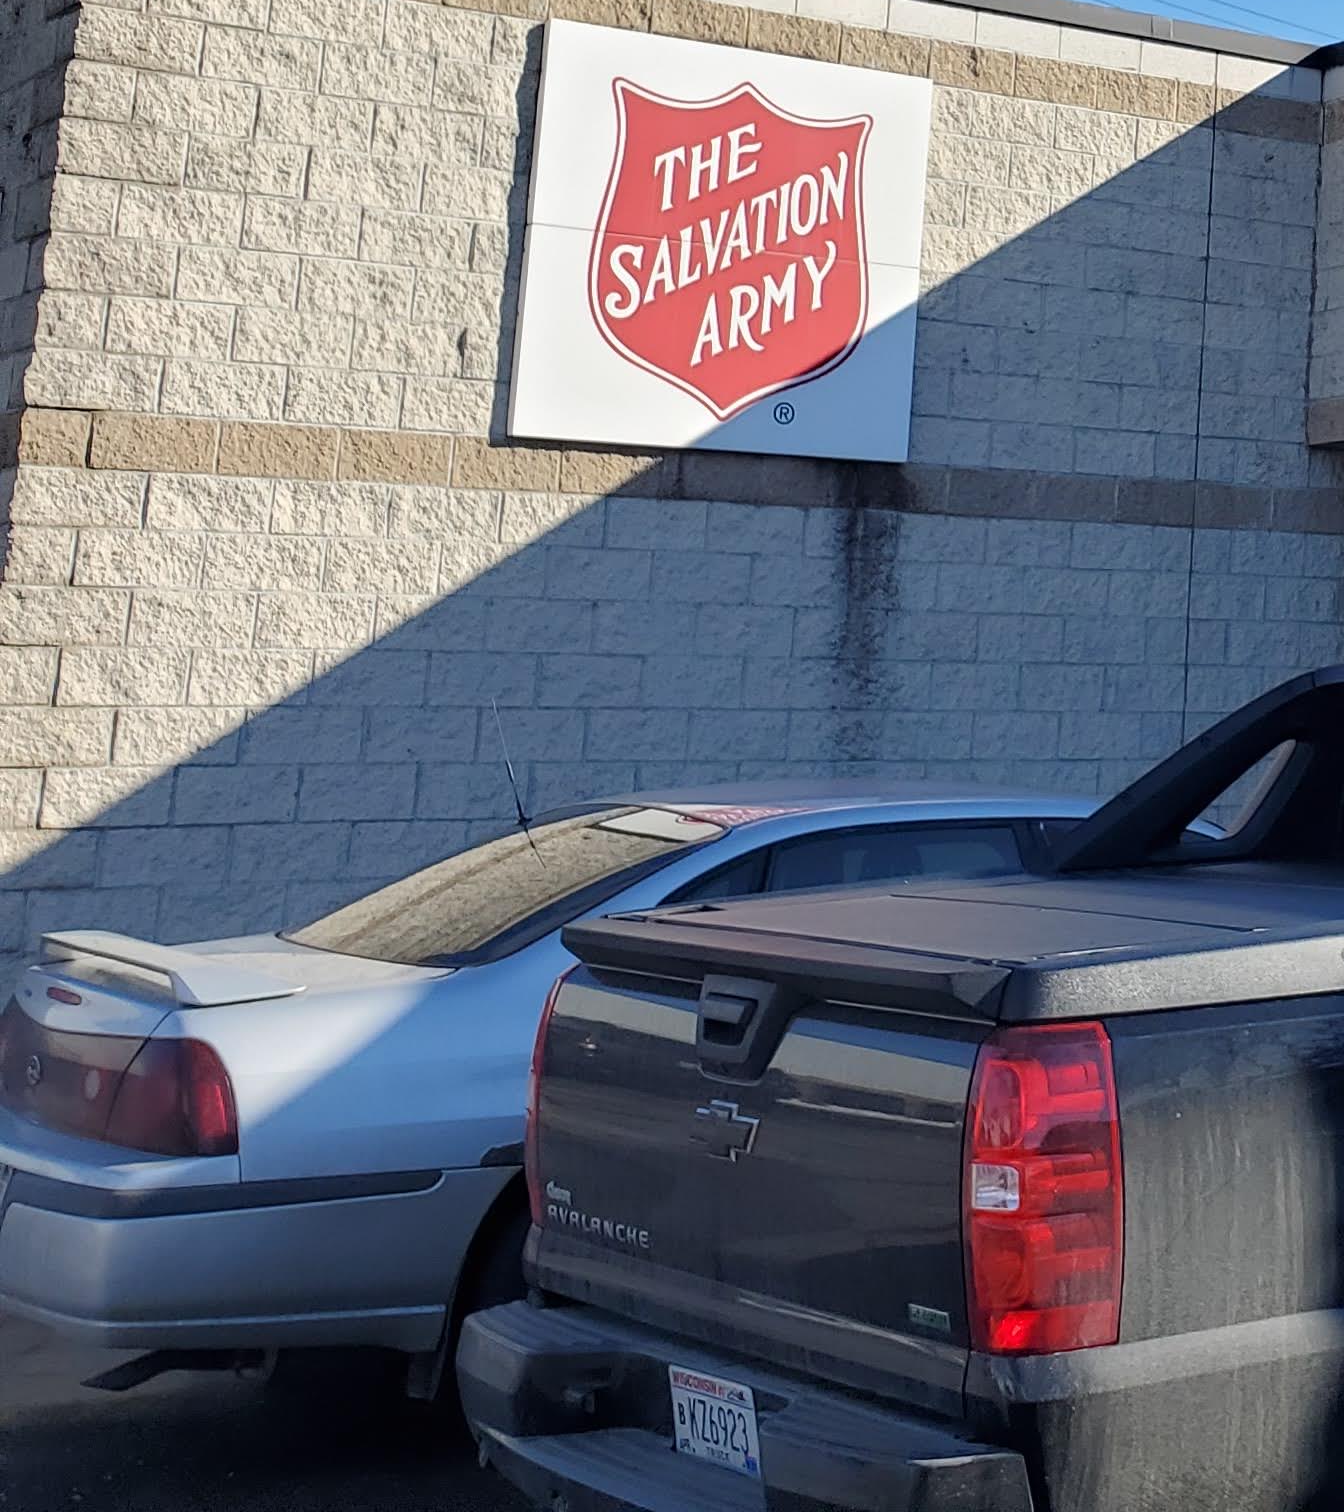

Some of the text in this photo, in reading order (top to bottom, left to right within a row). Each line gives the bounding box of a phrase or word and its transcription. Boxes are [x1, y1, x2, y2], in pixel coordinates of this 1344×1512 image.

[654, 122, 763, 212] THE
[604, 151, 849, 319] SALVATION
[690, 240, 837, 367] ARMY
[547, 1204, 650, 1249] AVALANCHE
[688, 1396, 750, 1456] KZ6923
